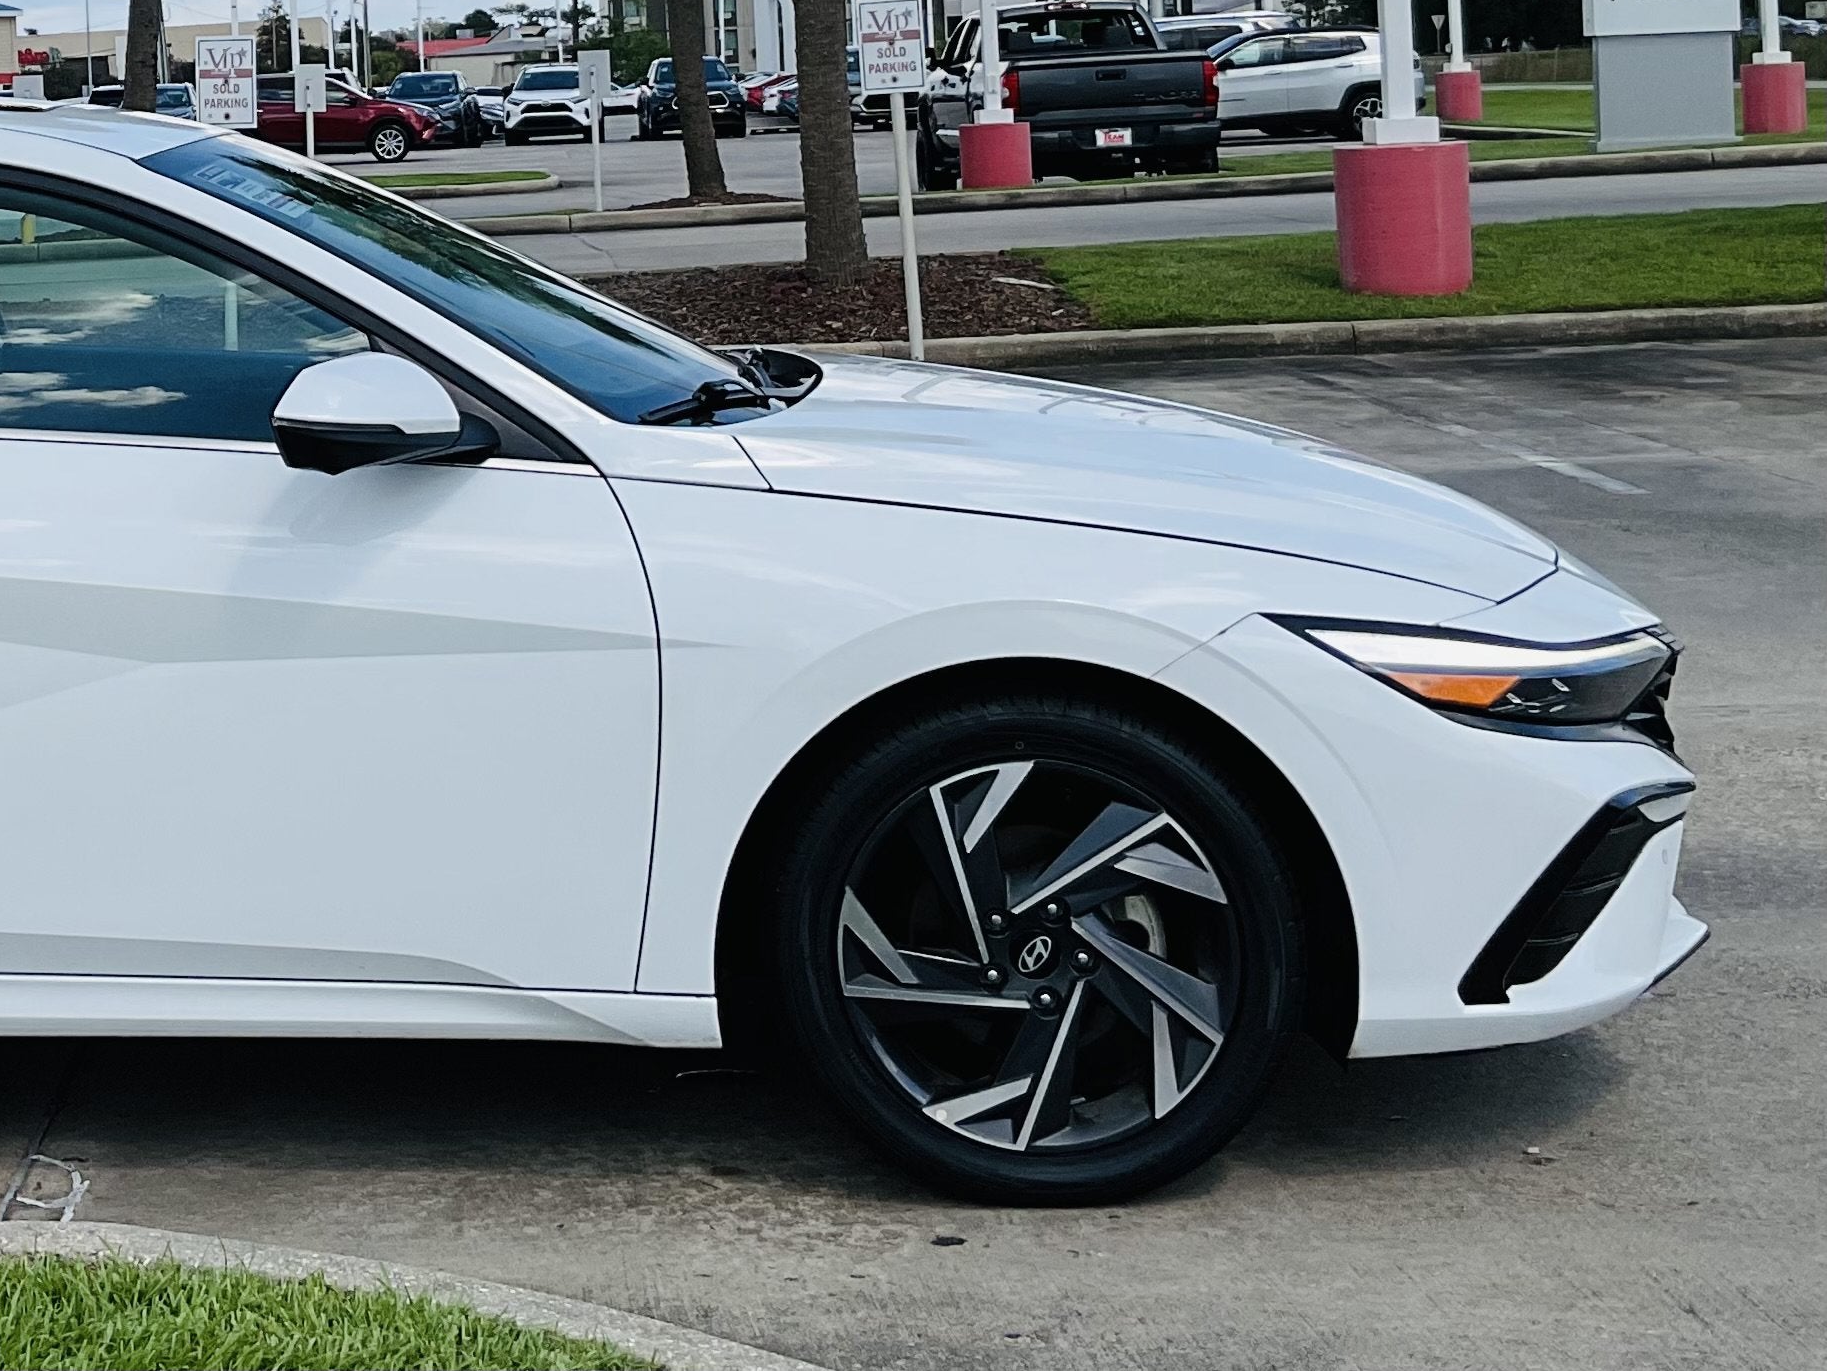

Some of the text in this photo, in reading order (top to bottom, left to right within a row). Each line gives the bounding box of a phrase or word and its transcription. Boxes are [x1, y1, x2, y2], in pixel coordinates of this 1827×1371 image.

[876, 46, 907, 59] SOLD
[868, 61, 917, 75] PARKING
[212, 83, 240, 94] SOLD
[204, 98, 249, 109] PARKING
